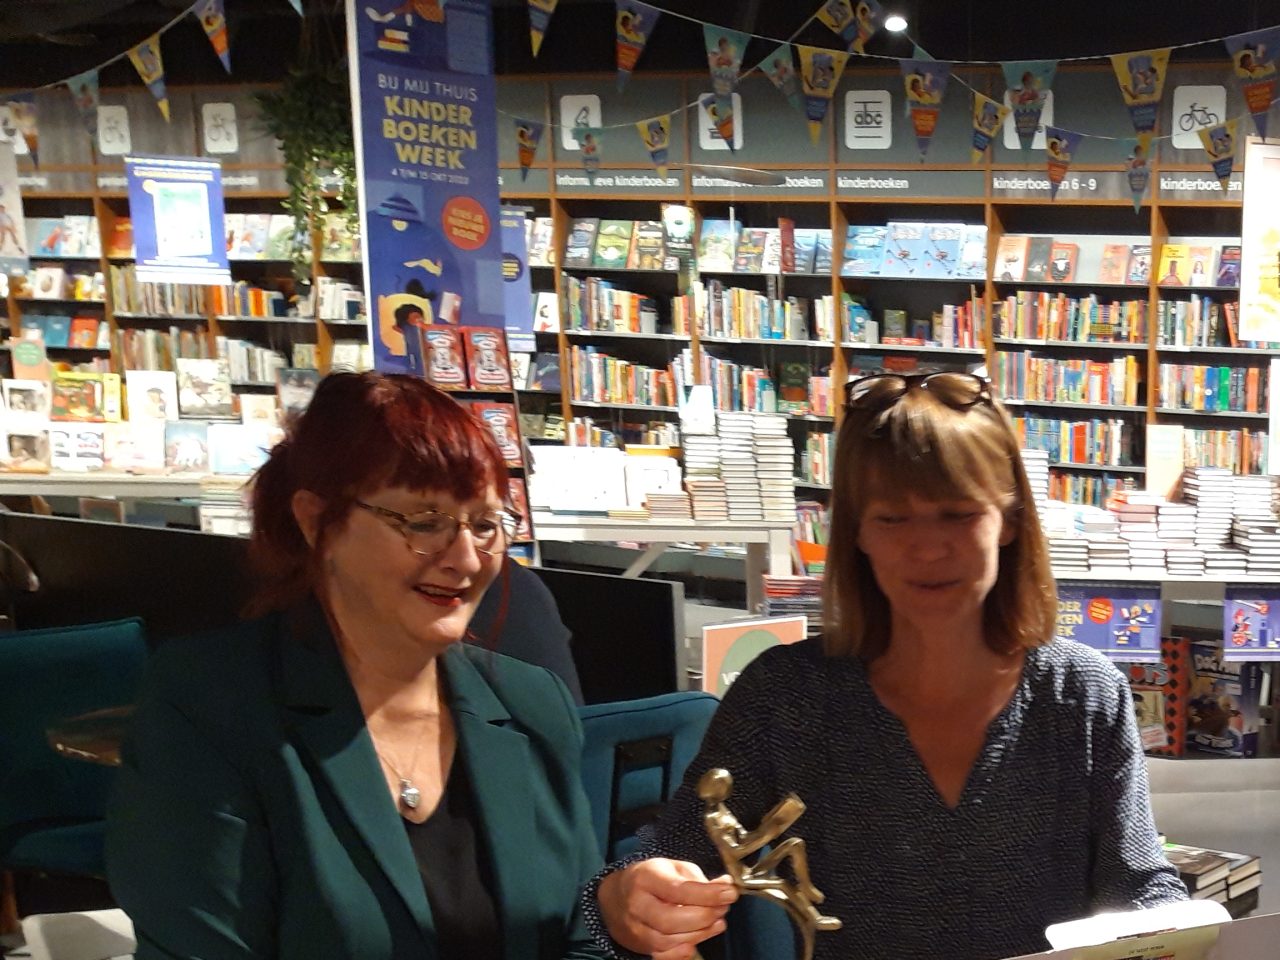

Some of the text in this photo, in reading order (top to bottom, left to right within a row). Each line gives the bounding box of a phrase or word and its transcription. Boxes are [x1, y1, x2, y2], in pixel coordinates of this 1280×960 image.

[433, 82, 478, 102] THUIS
[384, 95, 473, 127] KINDER
[382, 119, 477, 150] BOEKEN
[394, 142, 465, 170] WEEK
[837, 176, 910, 189] kinderboeken
[992, 177, 1070, 190] kinderboen
[1071, 178, 1080, 190] 6
[1087, 178, 1097, 191] 9
[1160, 178, 1242, 191] kinderboeen
[1055, 601, 1081, 613] DER
[1055, 614, 1083, 625] KEN
